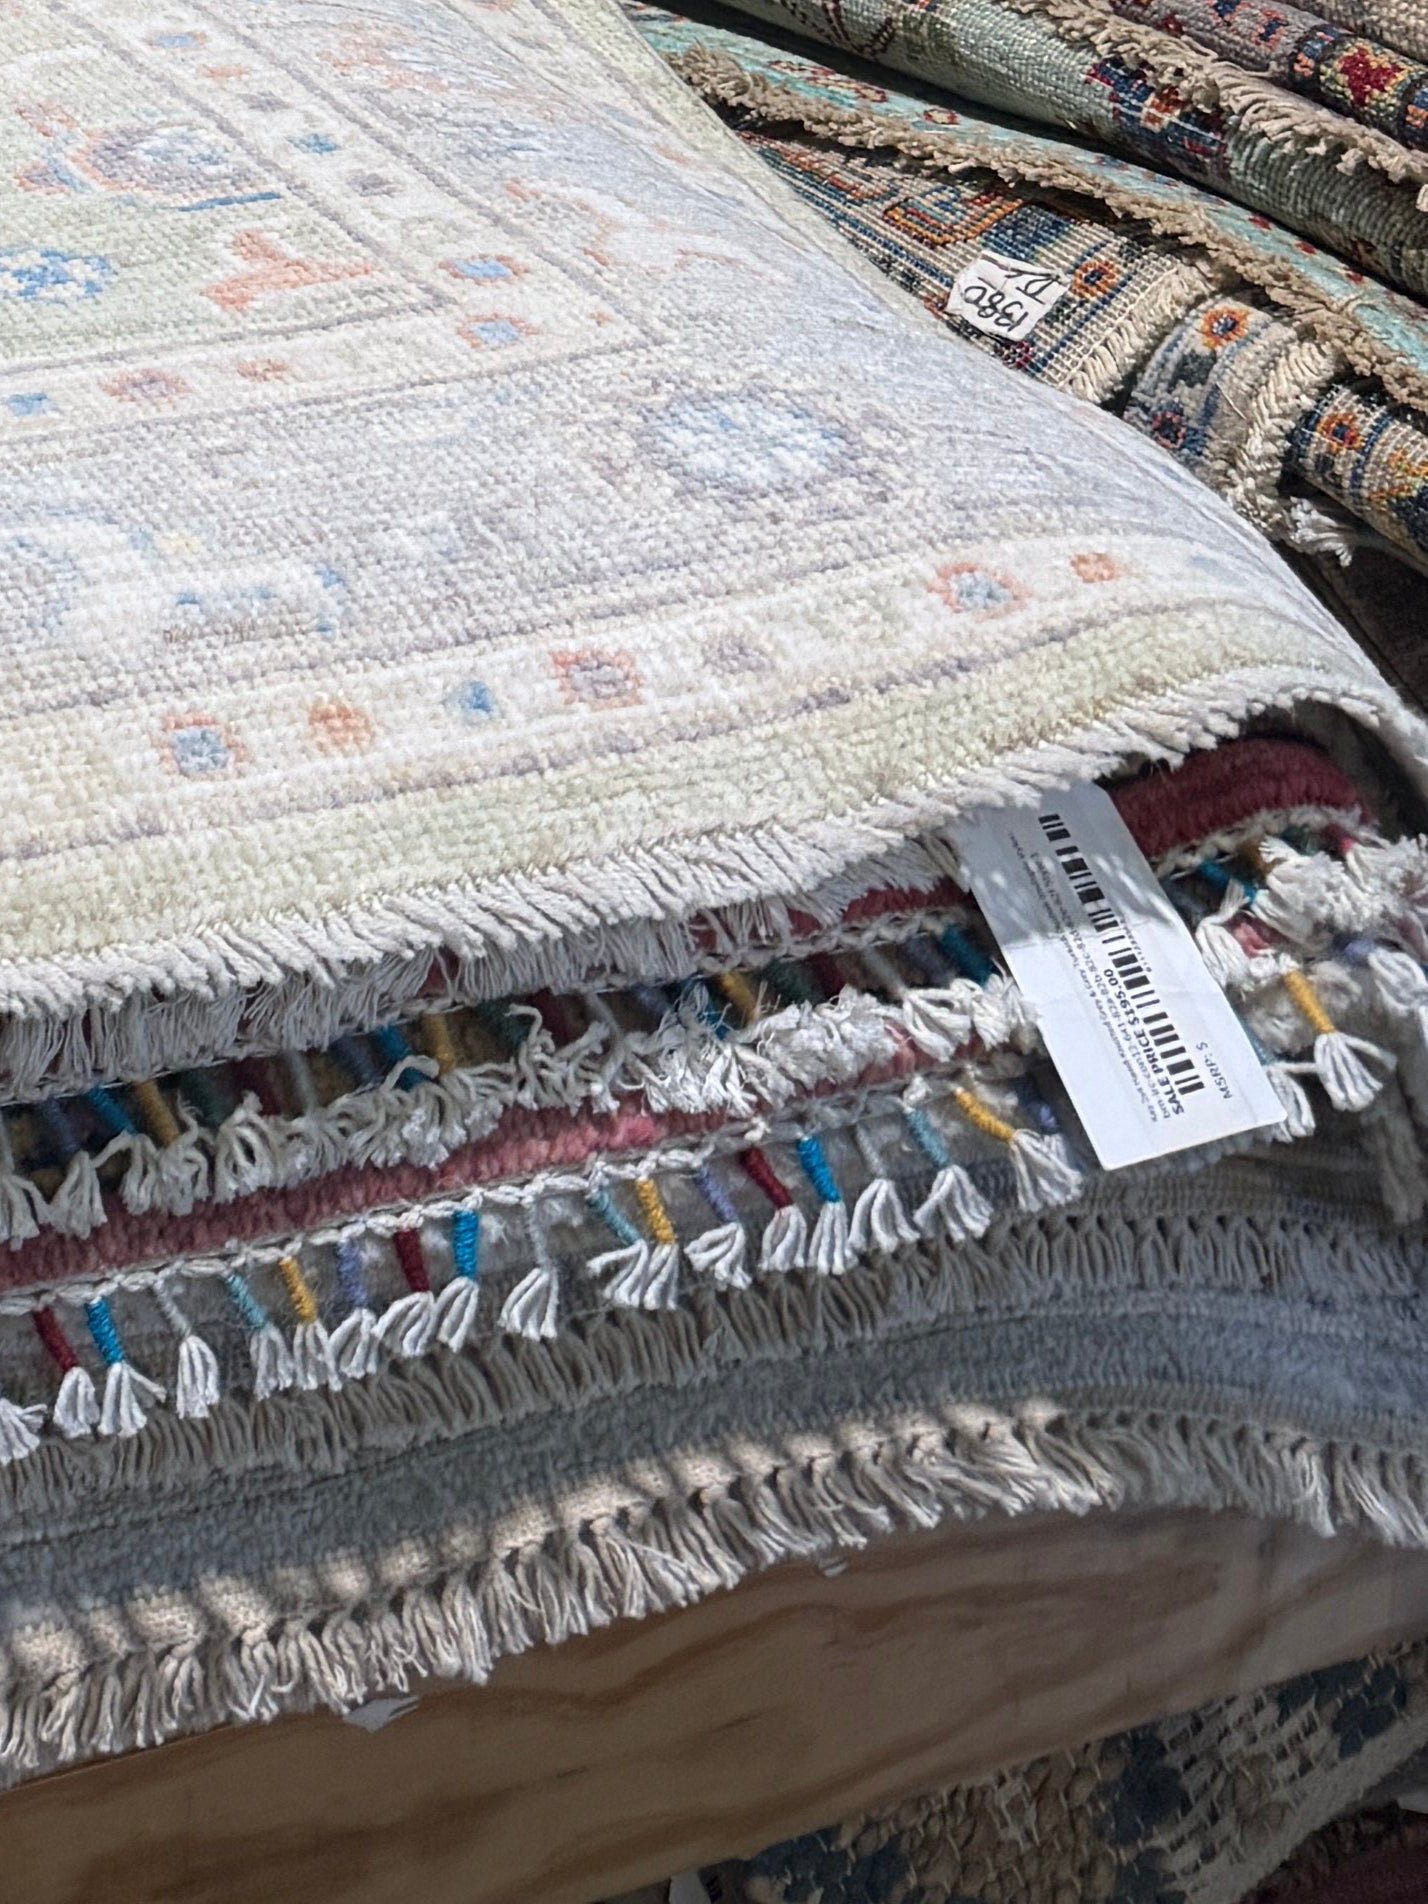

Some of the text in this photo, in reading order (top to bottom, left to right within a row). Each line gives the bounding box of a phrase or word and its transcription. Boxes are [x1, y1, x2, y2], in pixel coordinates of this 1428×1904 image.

[963, 285, 1030, 332] 1380
[1101, 966, 1140, 1027] $195.00
[1132, 1027, 1164, 1075] PRICE
[1201, 1050, 1234, 1100] MSRP:
[1155, 1073, 1185, 1115] SALE
